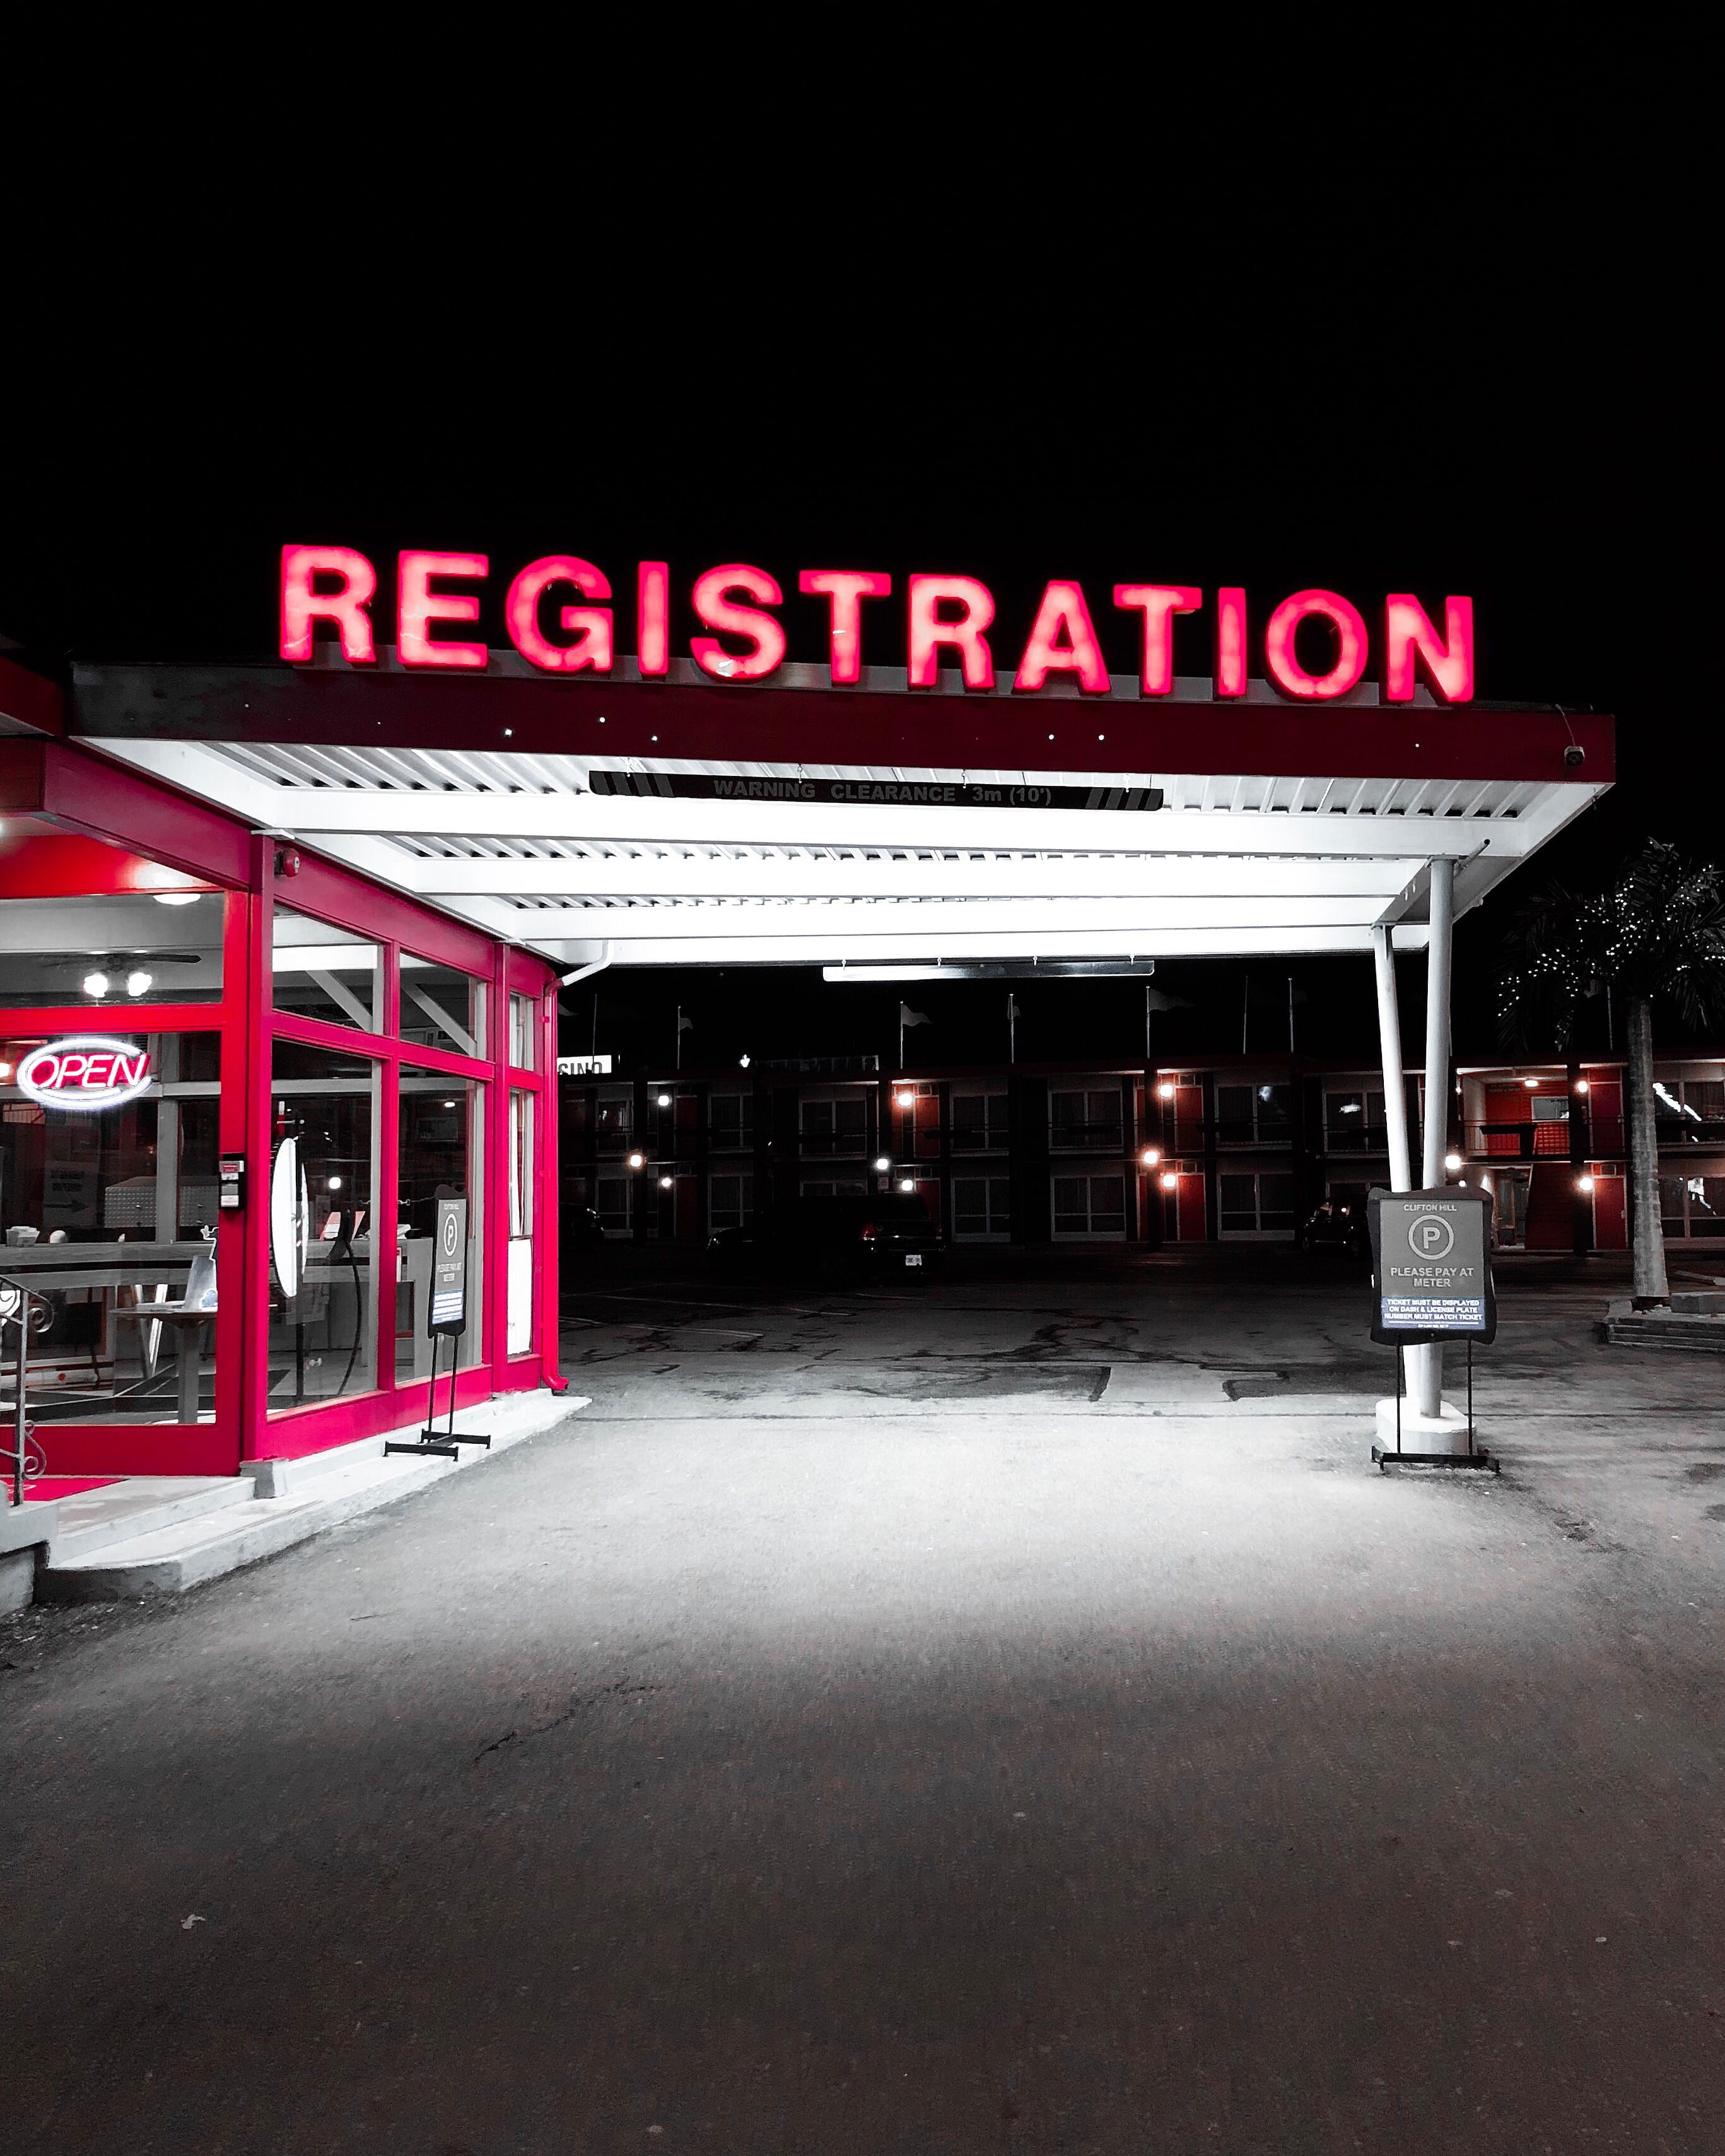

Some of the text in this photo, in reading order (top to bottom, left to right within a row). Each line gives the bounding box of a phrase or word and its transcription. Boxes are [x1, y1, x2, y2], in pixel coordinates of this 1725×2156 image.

[281, 545, 1474, 702] REGISTRATION
[713, 780, 1051, 806] WARNING CLEARANCE 3m (10')
[26, 1053, 149, 1089] OPEN
[447, 1225, 454, 1246] P
[1423, 1227, 1441, 1250] P
[1390, 1267, 1474, 1277] PLEASE PAY AT
[1413, 1278, 1451, 1287] METER
